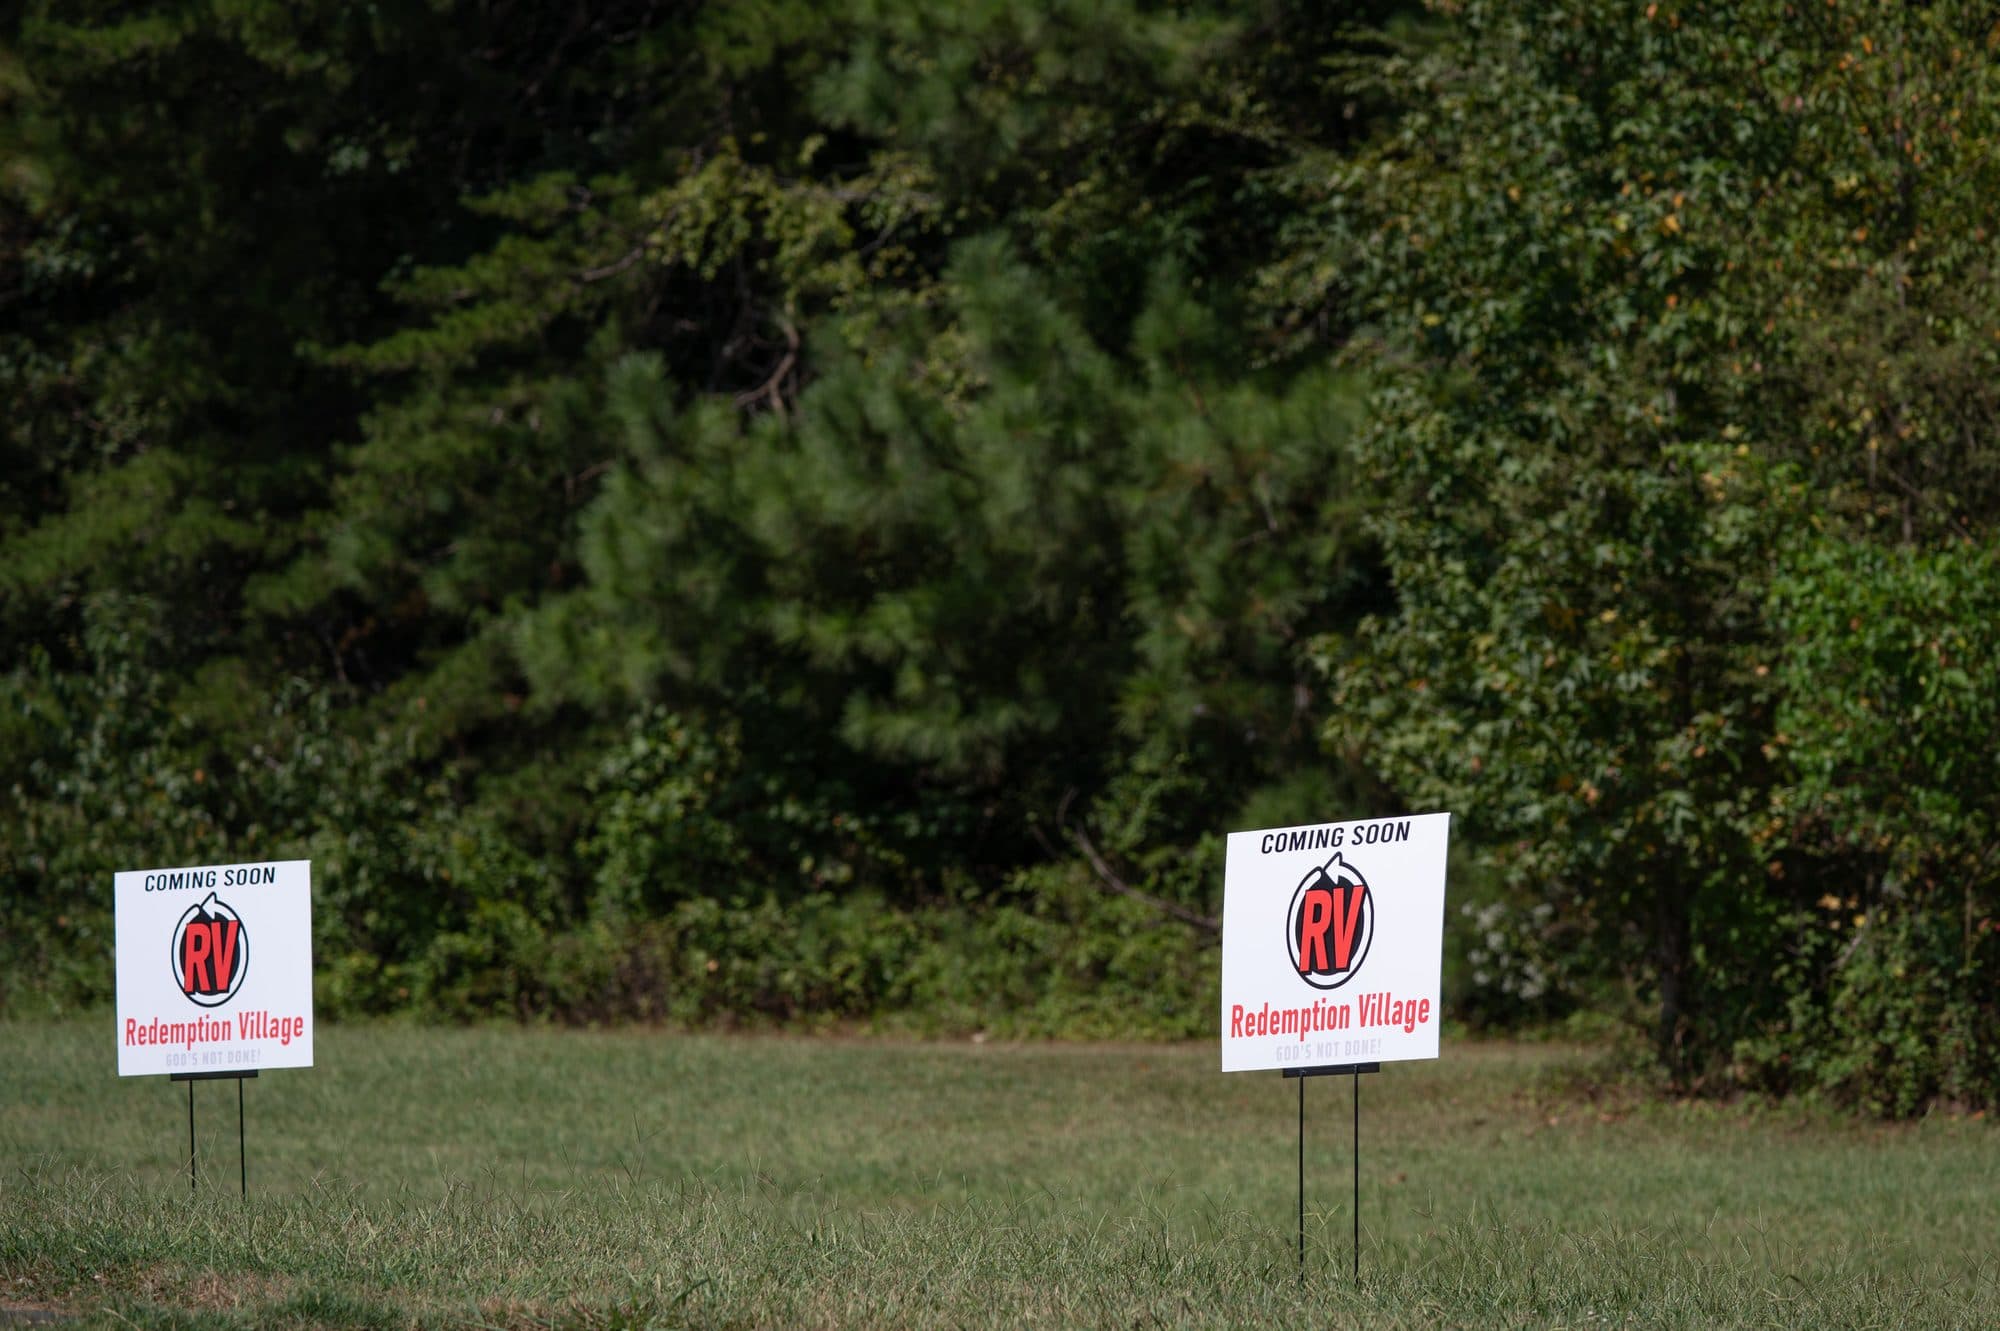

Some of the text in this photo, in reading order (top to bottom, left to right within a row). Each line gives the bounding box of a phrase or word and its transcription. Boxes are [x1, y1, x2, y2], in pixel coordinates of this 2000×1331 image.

[1261, 821, 1411, 854] COMING SOON
[145, 867, 276, 892] COMING SOON
[1300, 885, 1365, 973] RV
[184, 920, 239, 993] RV
[125, 1011, 304, 1050] Redemption Village
[1231, 992, 1430, 1041] Redemption Village
[166, 1048, 261, 1066] GOD'S NOT DONE!
[1276, 1038, 1382, 1061] GOD'S NOT DONE!
